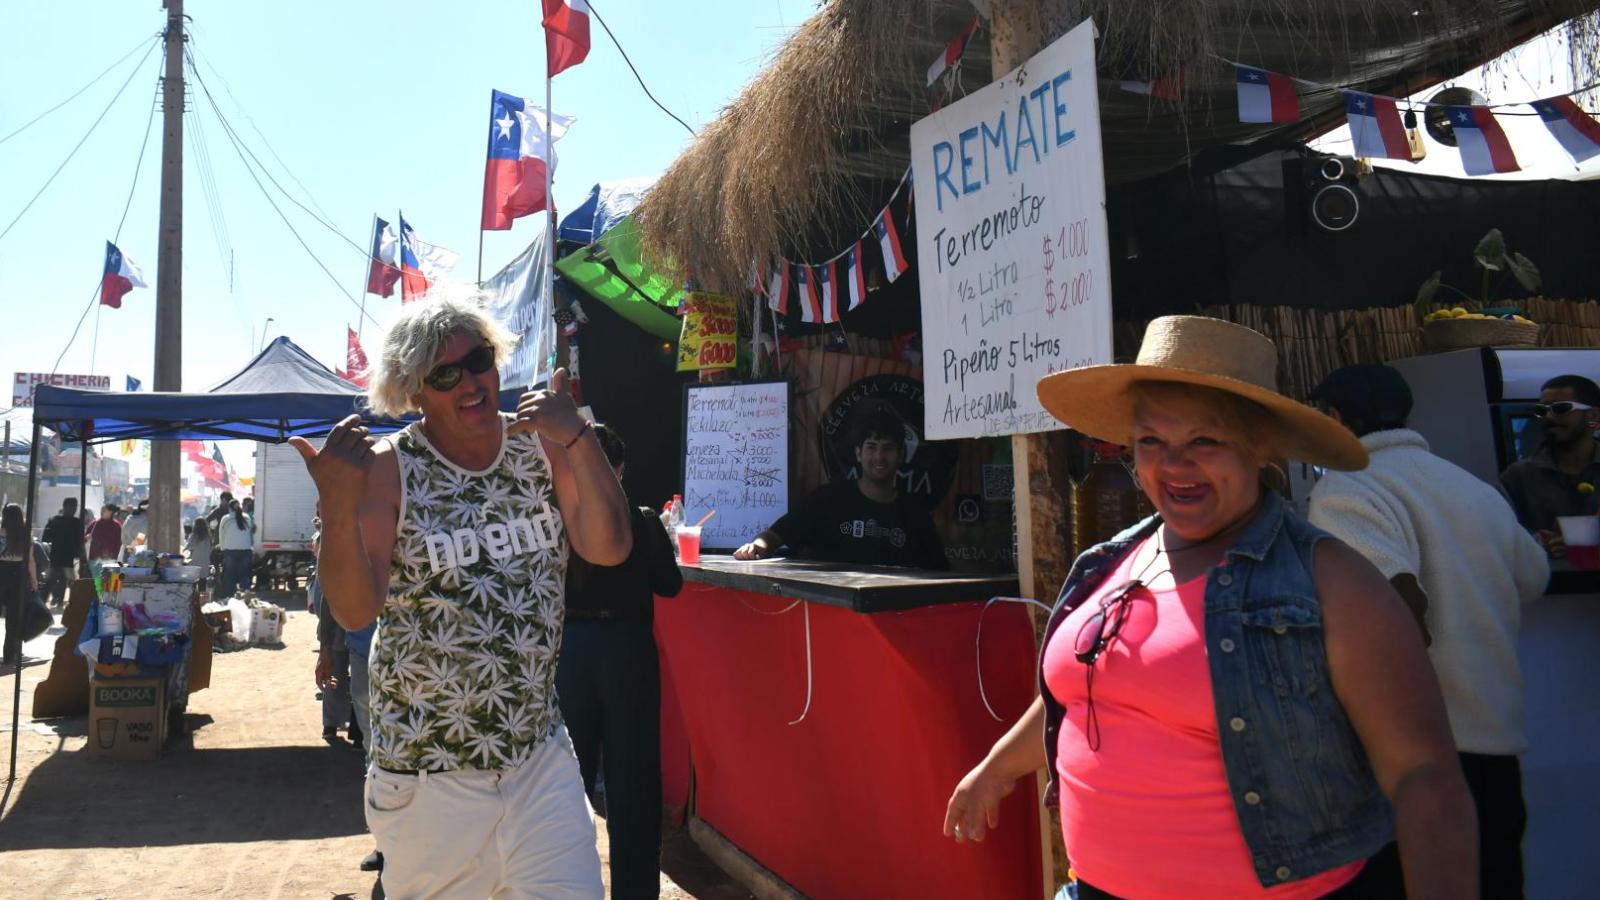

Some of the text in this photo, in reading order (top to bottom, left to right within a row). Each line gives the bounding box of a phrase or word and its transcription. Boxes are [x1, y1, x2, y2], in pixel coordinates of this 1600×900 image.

[932, 70, 1077, 214] REMATE
[933, 182, 1046, 274] Terremoto
[979, 261, 1018, 296] Litro
[980, 297, 1013, 328] Litro
[15, 371, 111, 387] CHICHERIA
[943, 338, 1003, 392] Pipeño
[1007, 340, 1020, 368] 5
[1022, 331, 1061, 363] Litros
[943, 372, 1017, 424] Artesanal
[100, 687, 150, 702] BOOKA
